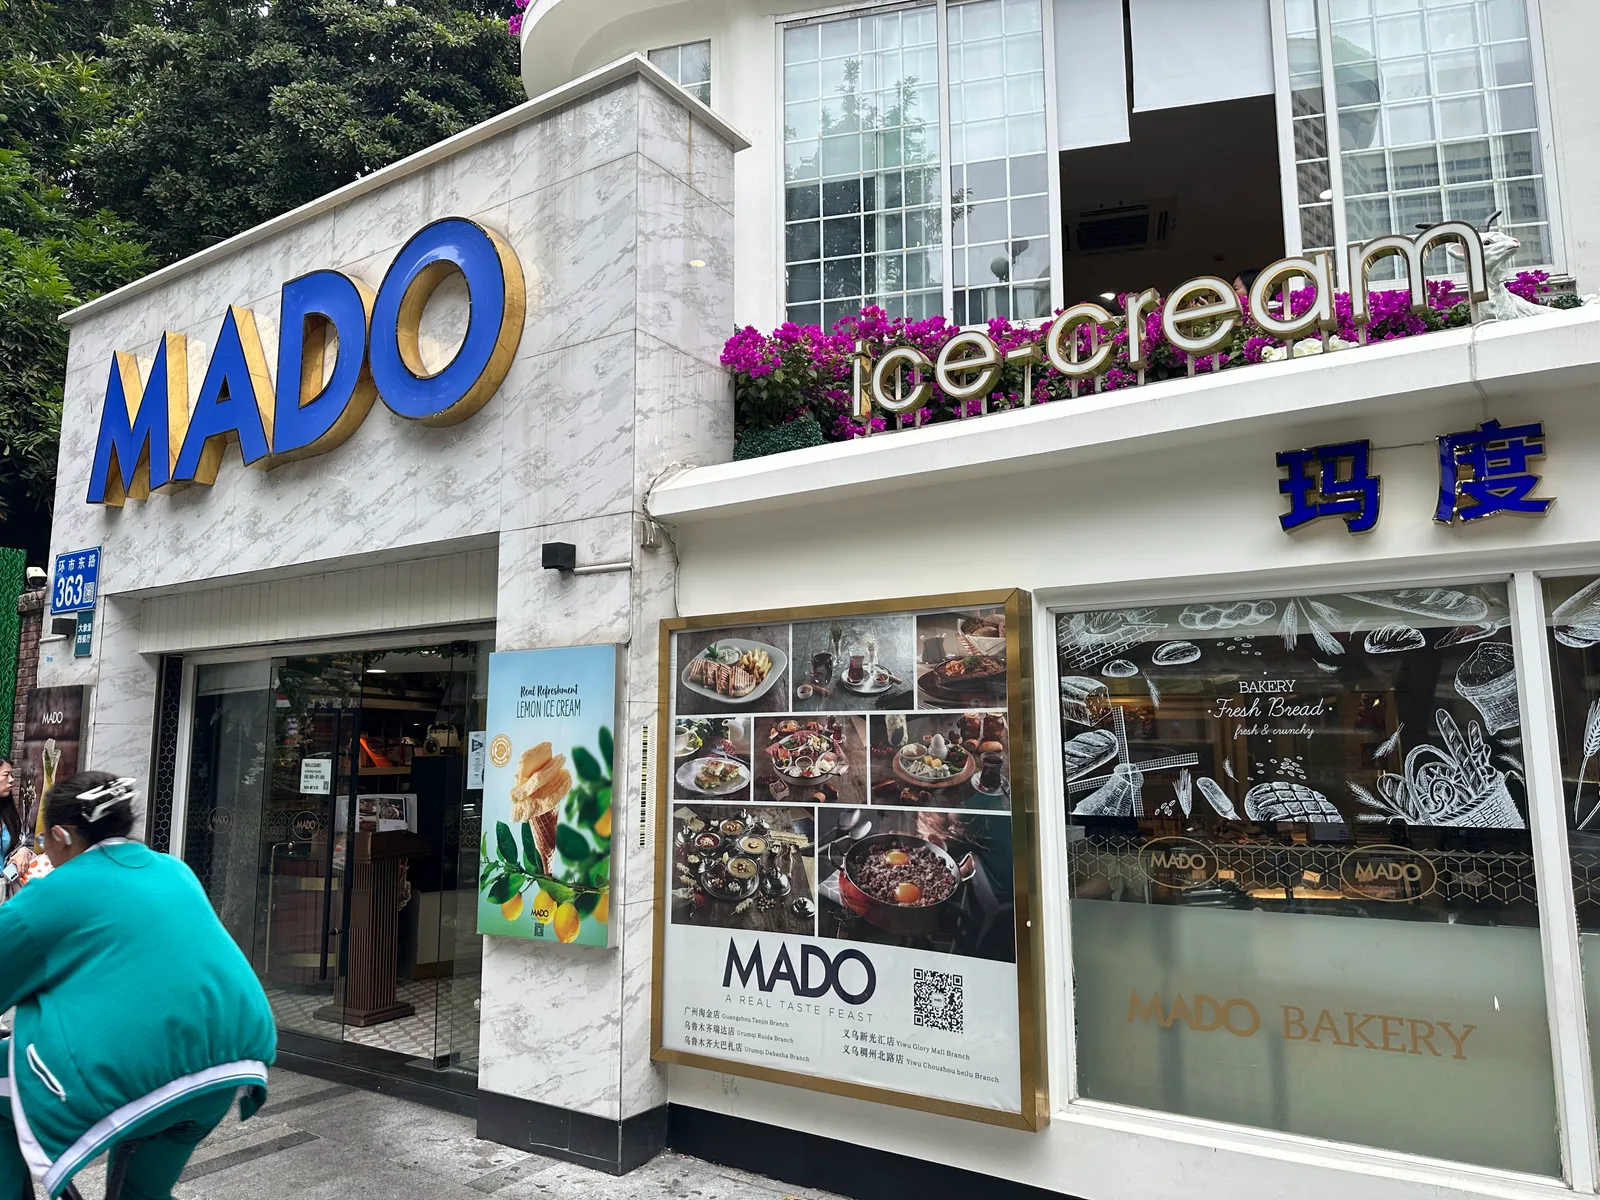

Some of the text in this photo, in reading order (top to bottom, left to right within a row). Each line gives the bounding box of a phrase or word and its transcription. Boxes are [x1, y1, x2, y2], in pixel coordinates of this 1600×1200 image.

[853, 220, 1490, 423] ice-cream
[86, 216, 526, 507] MADO
[1276, 417, 1557, 535] 玛度
[58, 554, 96, 573] 环市东路
[56, 574, 83, 608] 363
[520, 684, 579, 698] Real Refreshment
[1238, 679, 1296, 694] BAKERY
[41, 710, 64, 724] MADO
[516, 698, 581, 718] LEMON ICE CREAM
[1213, 697, 1324, 718] Fresh Bread
[1233, 723, 1315, 740] fresh & crunchy
[296, 819, 316, 830] MADO
[1150, 851, 1207, 870] MADO
[1354, 861, 1422, 882] MADO
[531, 909, 550, 918] MADO
[722, 936, 877, 1005] MADO
[684, 1006, 790, 1028] 广州淘金店 Guangzhou Taojin Branch
[724, 994, 874, 1023] A REAL TASTE FEAST
[684, 1020, 794, 1044] 乌鲁木齐瑞达店 Urumqi Ruida Branch
[1126, 988, 1477, 1060] MADO BAKERY
[684, 1035, 742, 1052] 乌鲁木齐大巴扎店
[744, 1046, 765, 1056] Urumqi
[789, 1053, 810, 1062] Branch
[842, 1029, 971, 1060] 义乌新光汇店 Yiwu Glory Mall Branch
[842, 1044, 1000, 1083] 义乌稠州北路店 Yiwu Chouzhou beilu Branch
